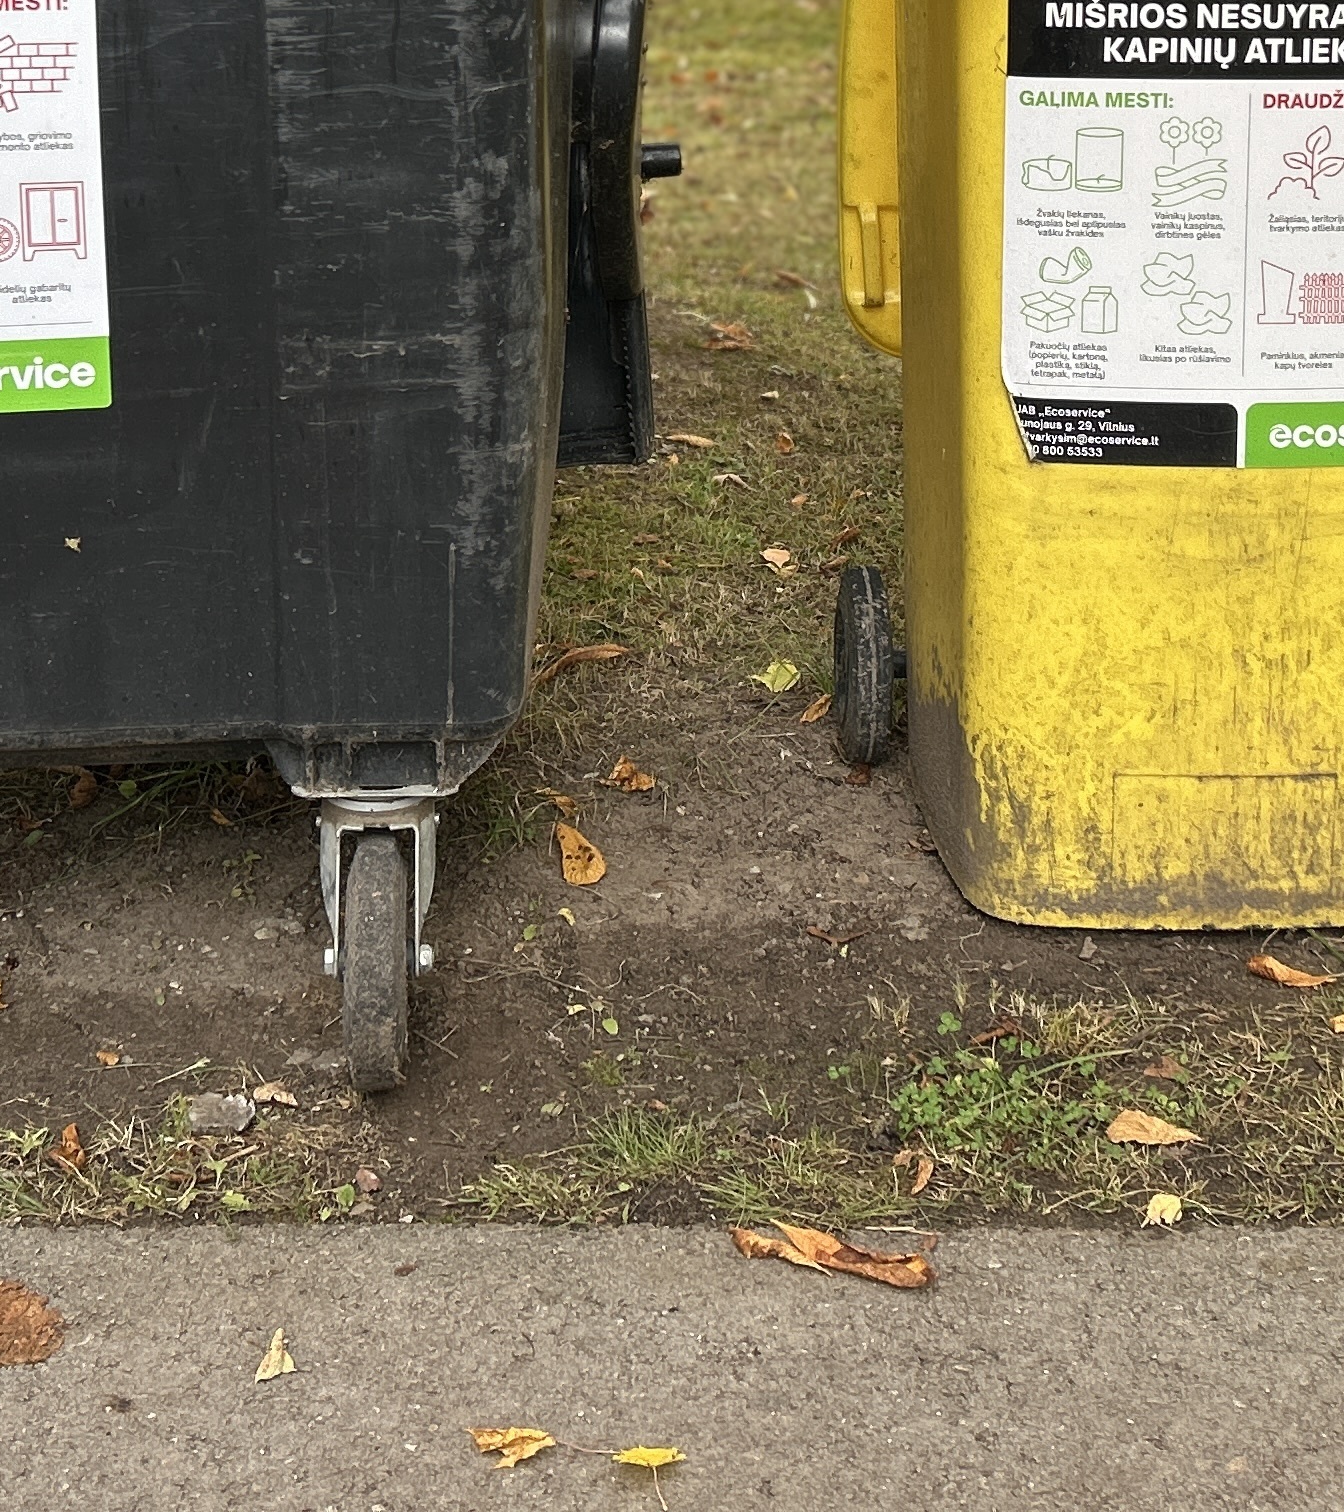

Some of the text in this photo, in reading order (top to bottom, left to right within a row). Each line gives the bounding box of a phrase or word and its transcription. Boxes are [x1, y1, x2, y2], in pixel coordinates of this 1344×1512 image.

[1103, 36, 1235, 69] KAPINIŲ
[1019, 90, 1174, 109] GALIMA MESTI:
[28, 132, 72, 142] griovimo
[34, 142, 73, 150] atliekas
[12, 295, 52, 304] atliekas
[1175, 355, 1186, 364] po
[1021, 419, 1135, 432] unojaus g. 29, Vilnius
[1043, 447, 1064, 455] 800
[1067, 447, 1103, 457] 53533
